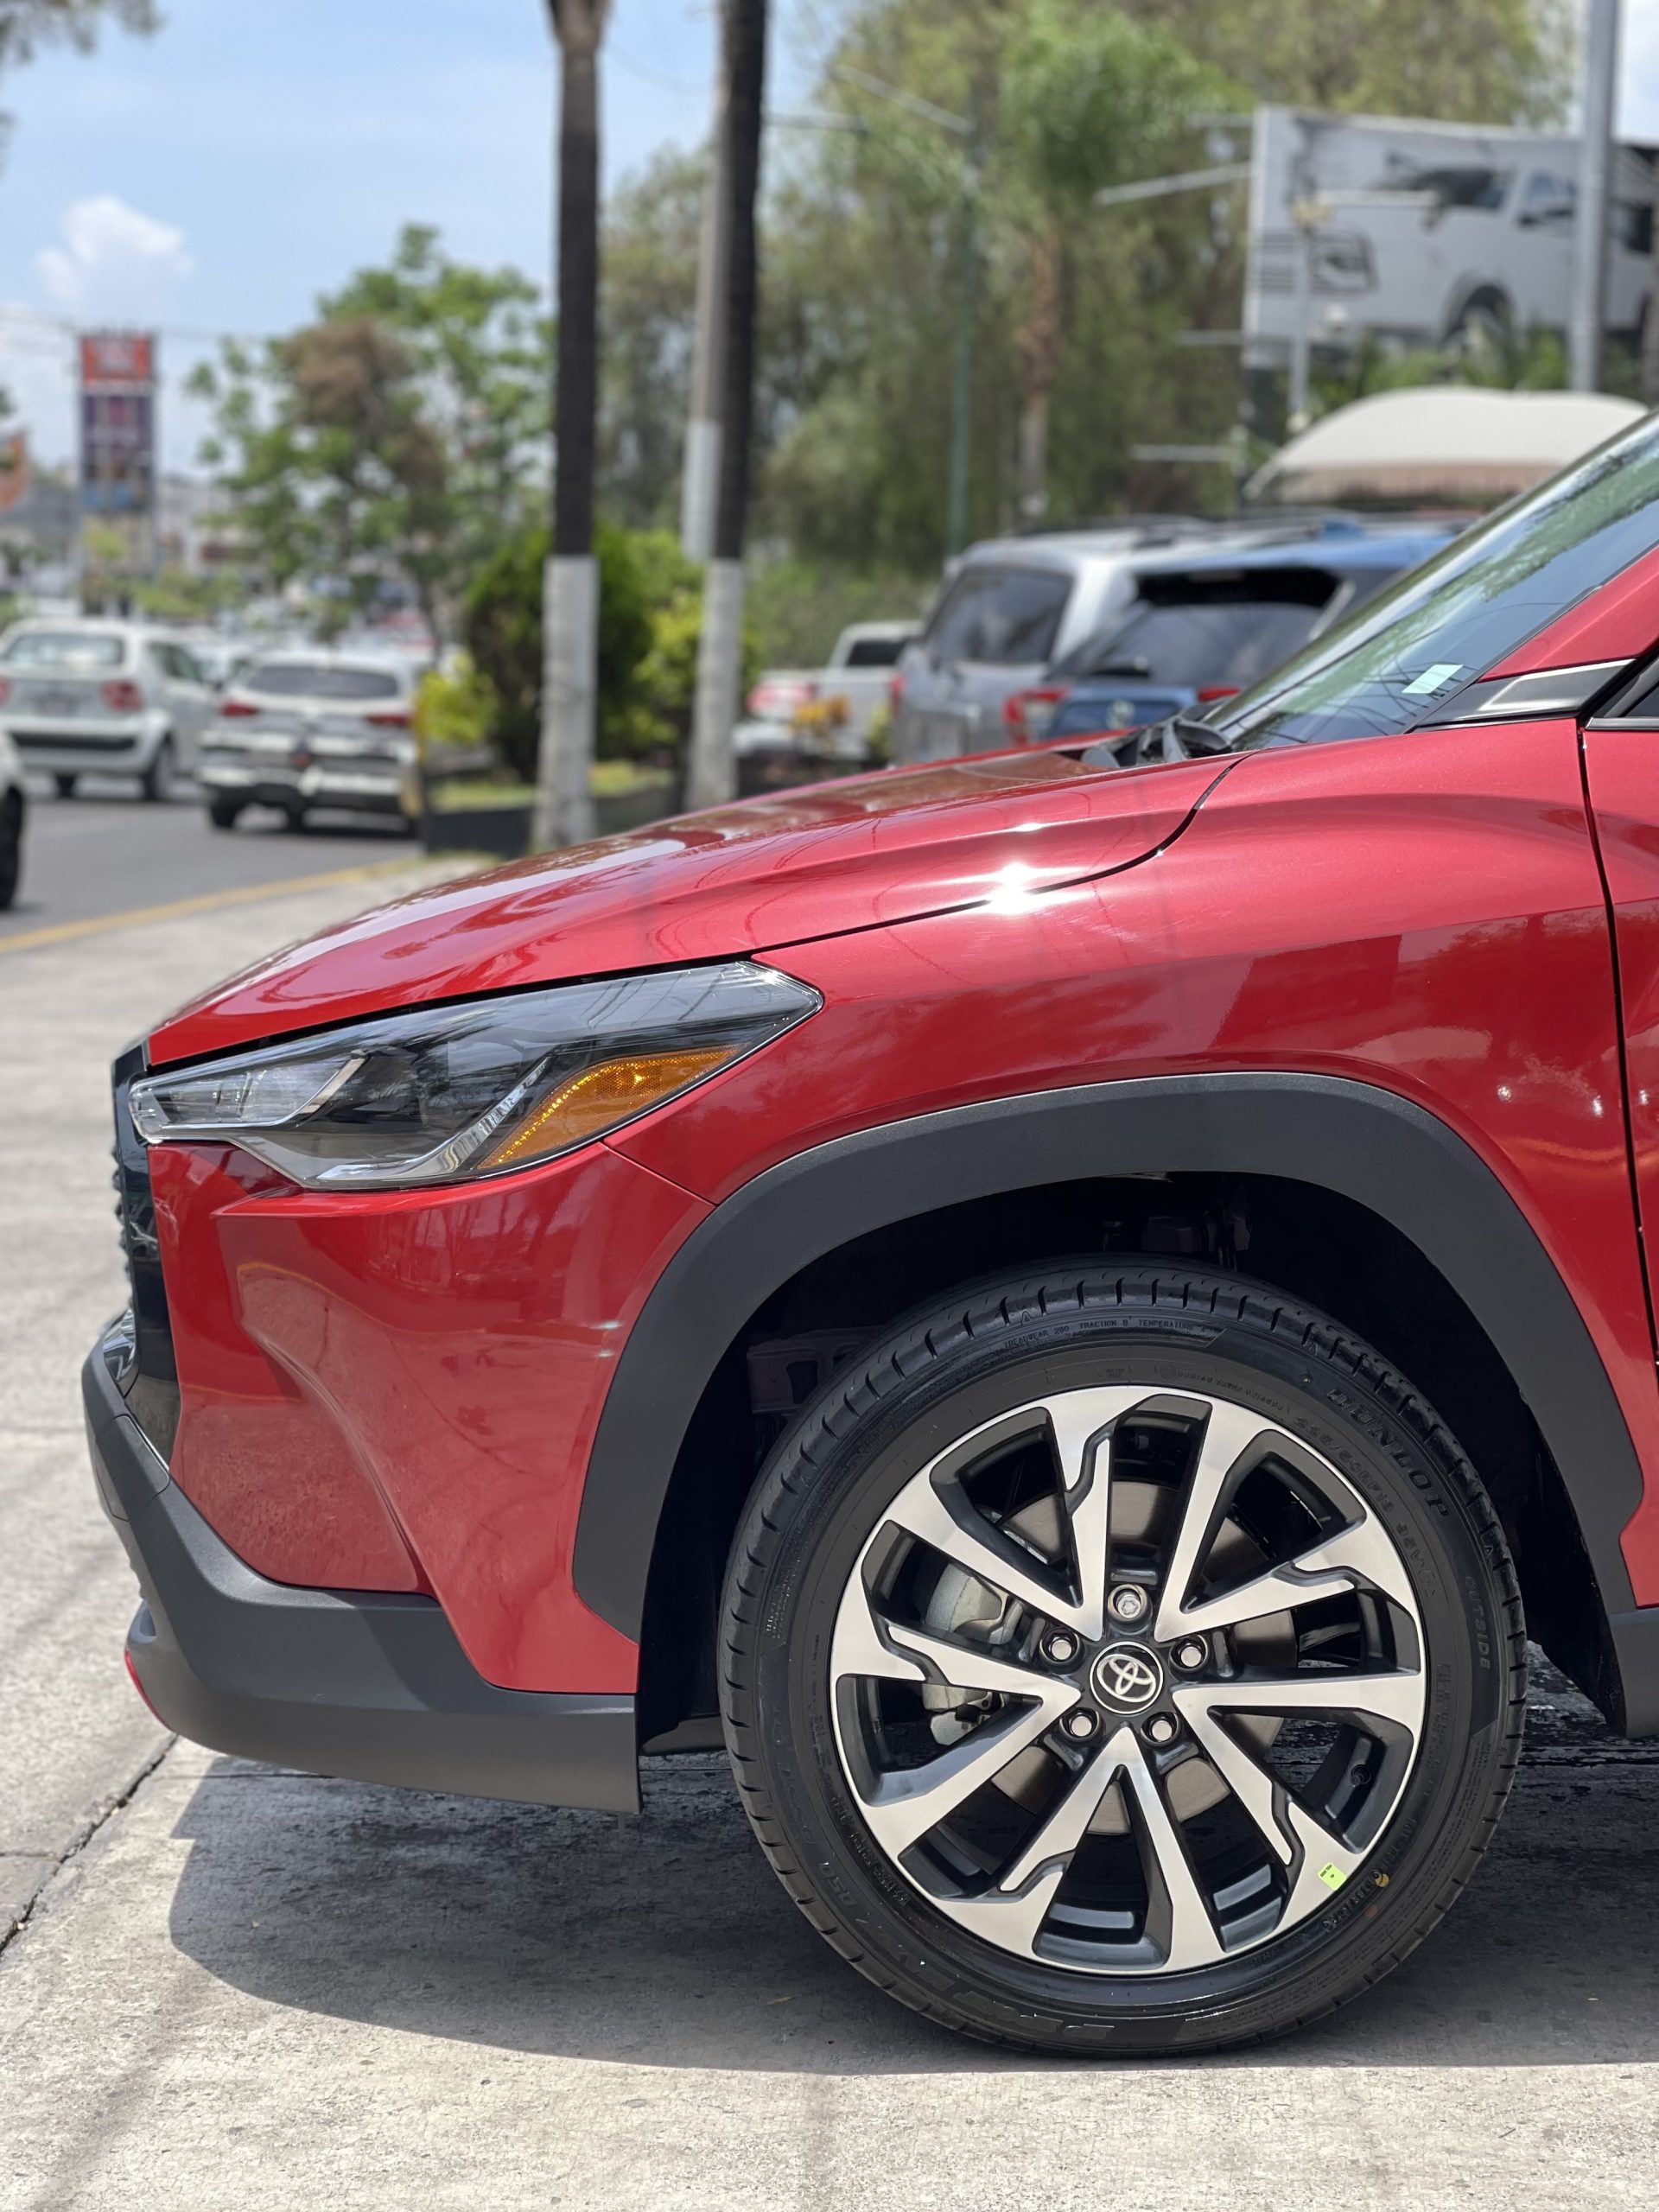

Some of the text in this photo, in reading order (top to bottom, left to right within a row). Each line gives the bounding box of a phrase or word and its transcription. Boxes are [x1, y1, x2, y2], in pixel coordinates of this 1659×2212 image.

[1003, 1329, 1049, 1349] TREADWEAR
[1079, 1319, 1117, 1330] TRACTION
[1327, 1389, 1450, 1517] DUNLOP
[1465, 1575, 1491, 1670] OUTSIDE
